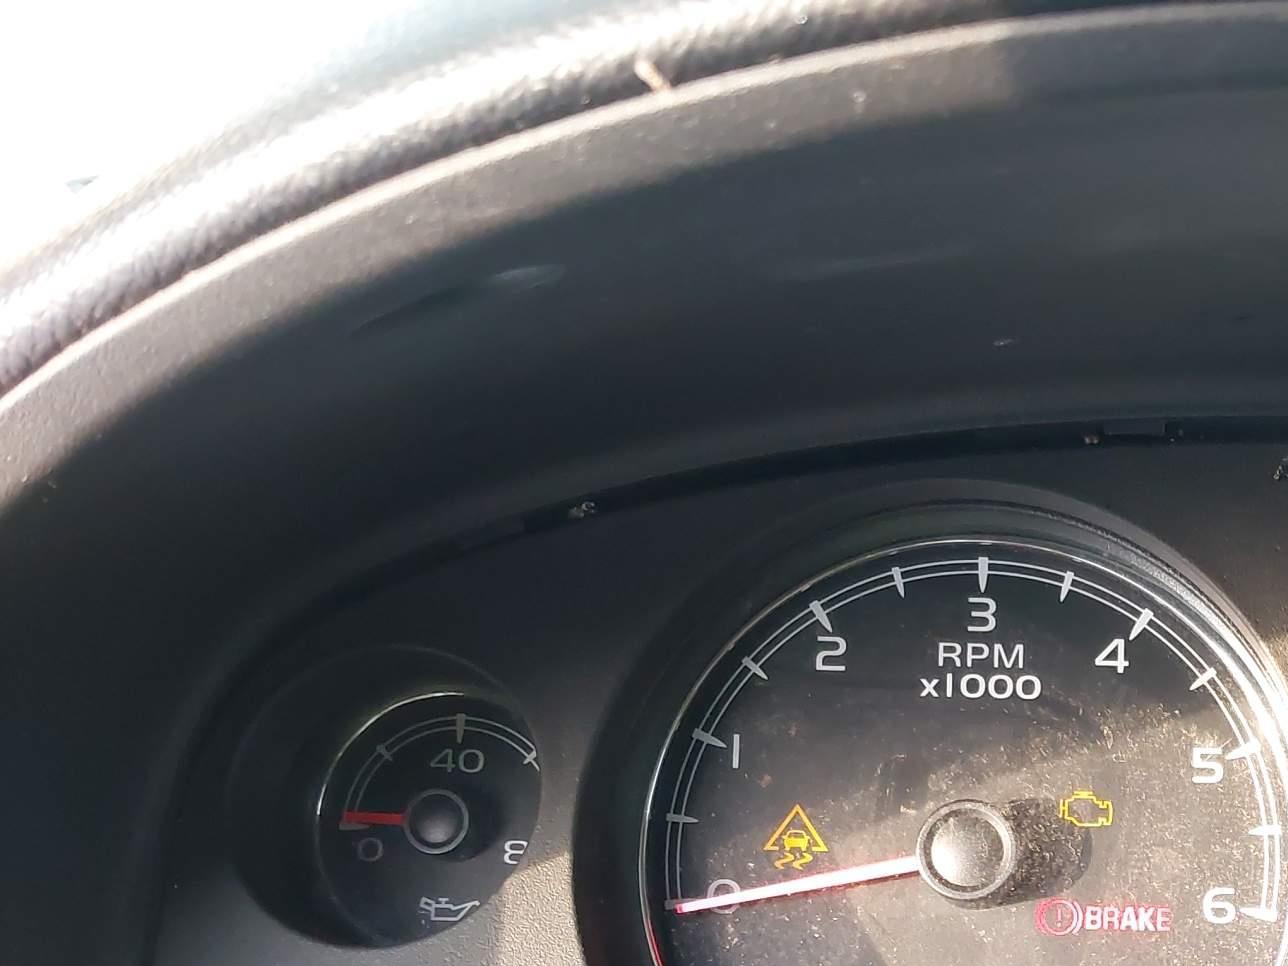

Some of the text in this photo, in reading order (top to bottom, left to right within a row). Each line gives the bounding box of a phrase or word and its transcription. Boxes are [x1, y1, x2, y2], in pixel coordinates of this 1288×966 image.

[967, 596, 997, 632] 3
[815, 636, 847, 671] 2
[938, 643, 1024, 669] RPM
[1095, 639, 1129, 674] 4
[920, 675, 1042, 700] x1000
[429, 748, 485, 773] 40
[731, 734, 741, 769] 1
[1190, 747, 1224, 783] 5
[357, 837, 383, 862] 0
[707, 879, 741, 914] 0
[1202, 887, 1237, 923] 6
[1083, 905, 1172, 931] BRAKE
